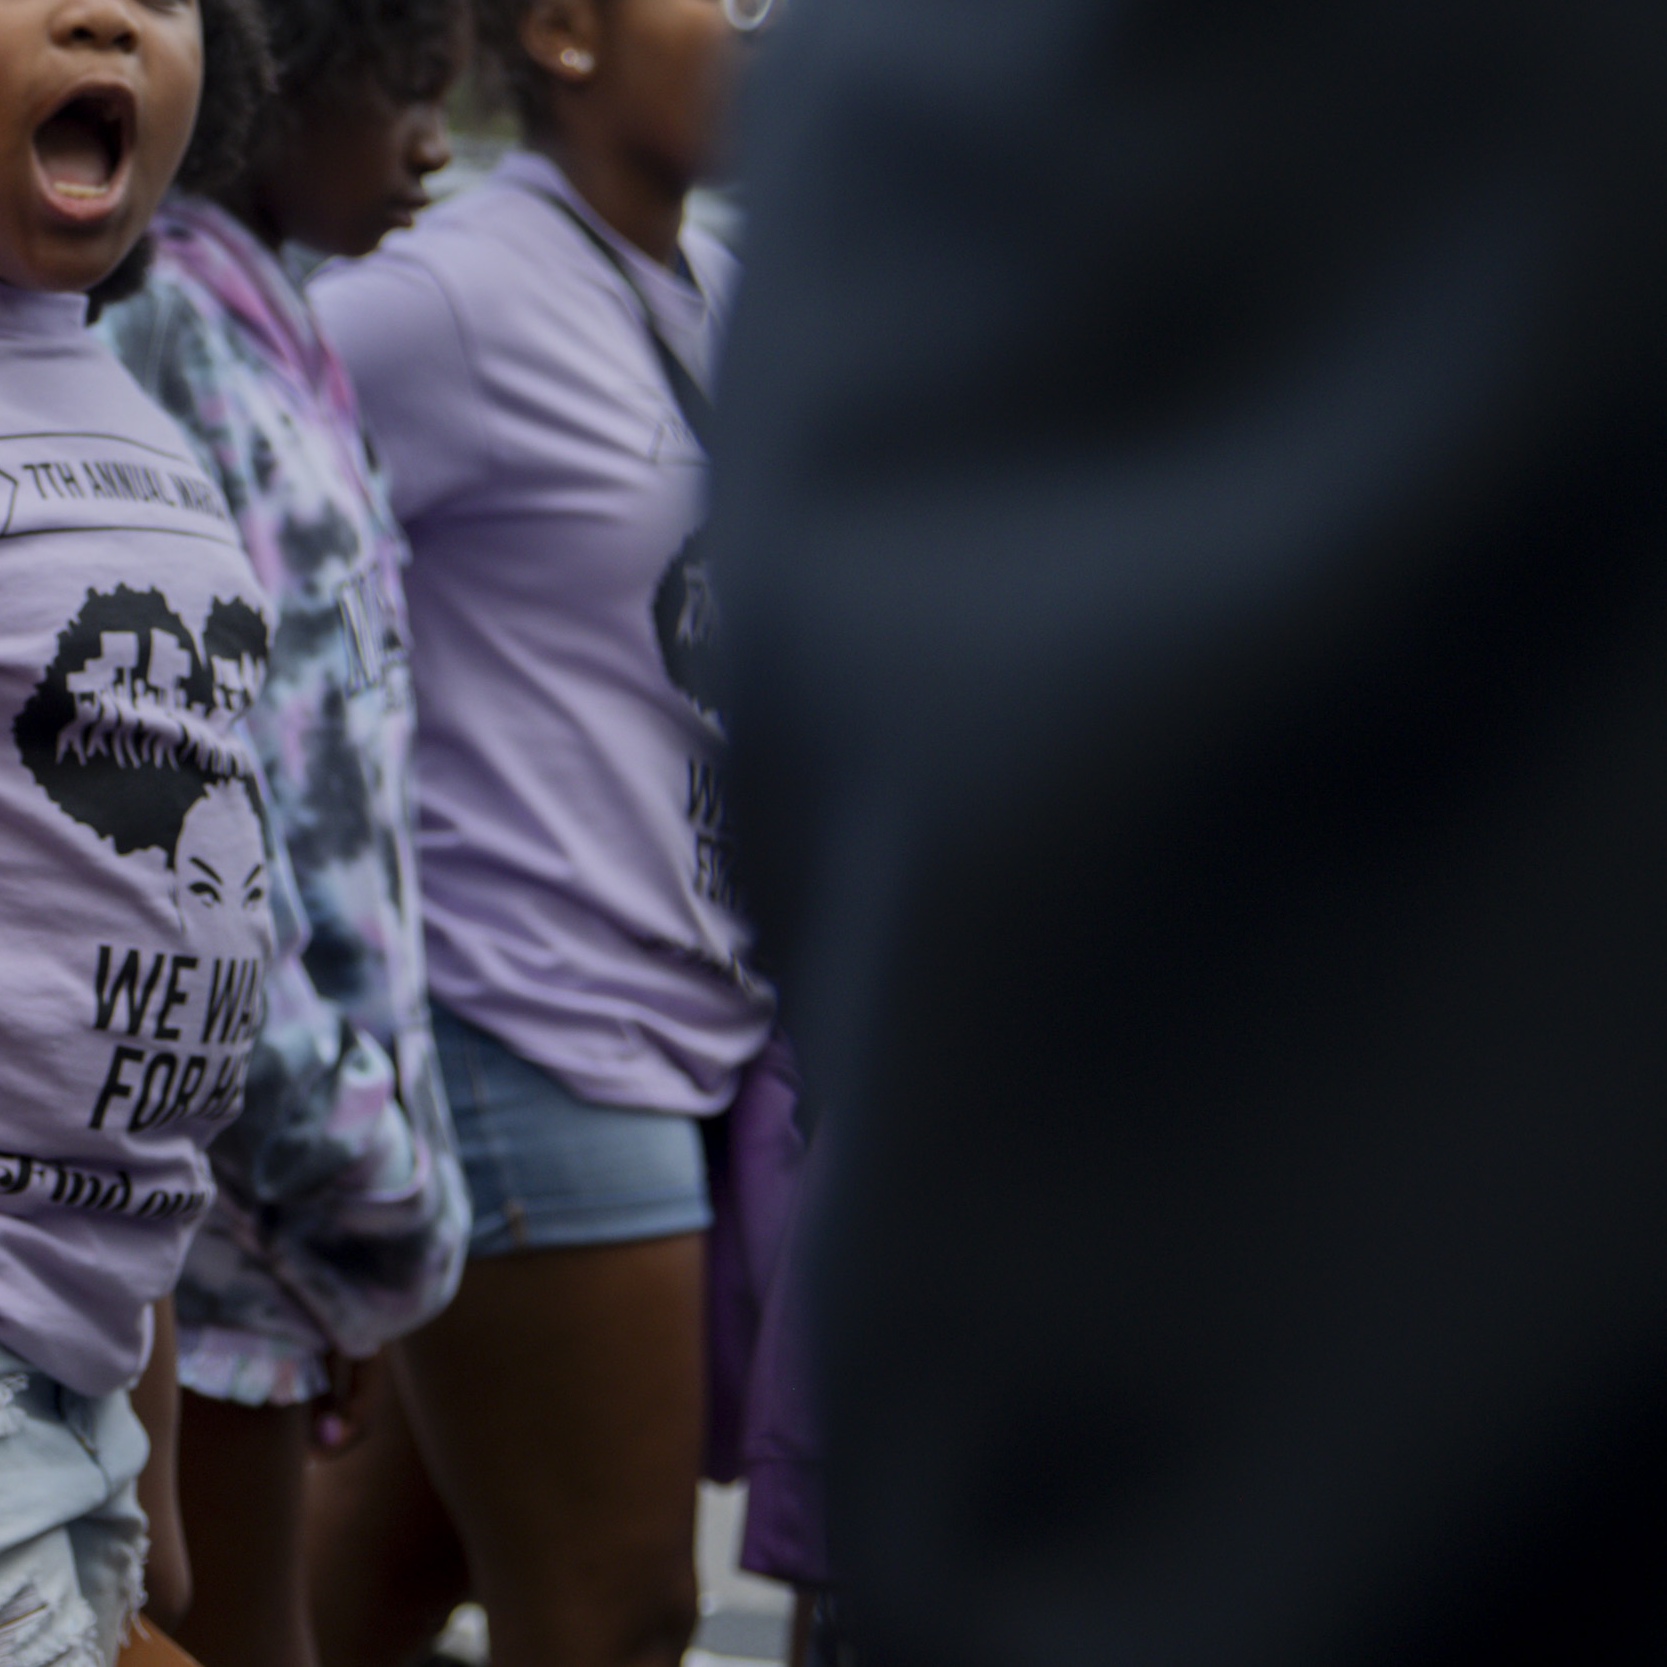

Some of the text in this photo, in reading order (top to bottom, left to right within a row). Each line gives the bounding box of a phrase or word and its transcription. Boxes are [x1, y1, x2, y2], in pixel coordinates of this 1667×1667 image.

[22, 462, 85, 500] 7TH
[81, 461, 176, 507] ANNUAL
[93, 945, 261, 1044] WE WA
[88, 1045, 209, 1133] FOR
